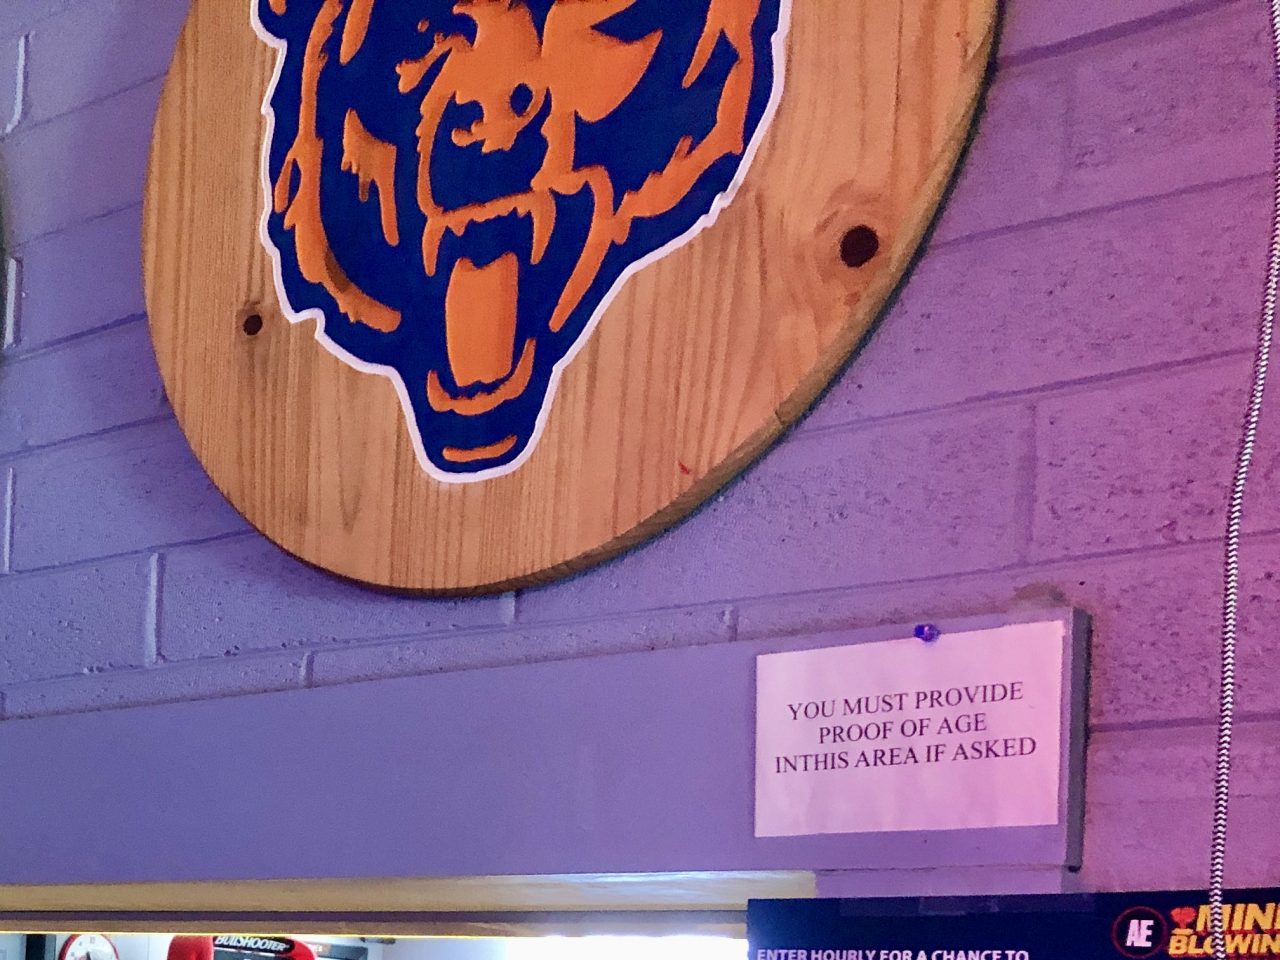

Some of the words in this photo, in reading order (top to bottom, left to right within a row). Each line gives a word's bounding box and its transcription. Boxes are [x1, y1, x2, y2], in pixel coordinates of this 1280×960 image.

[788, 701, 836, 721] YOU
[843, 693, 908, 716] MUST
[915, 682, 1024, 710] PROVIDE
[819, 721, 894, 744] PROOF
[901, 718, 930, 738] OF
[937, 713, 987, 734] AGE
[775, 751, 849, 774] INTHIS
[855, 748, 919, 768] AREA
[925, 744, 946, 764] IF
[952, 737, 1037, 761] ASKED
[1195, 903, 1280, 932] MIN
[215, 936, 287, 951] BULLSHOOTER
[1125, 919, 1154, 947] AE
